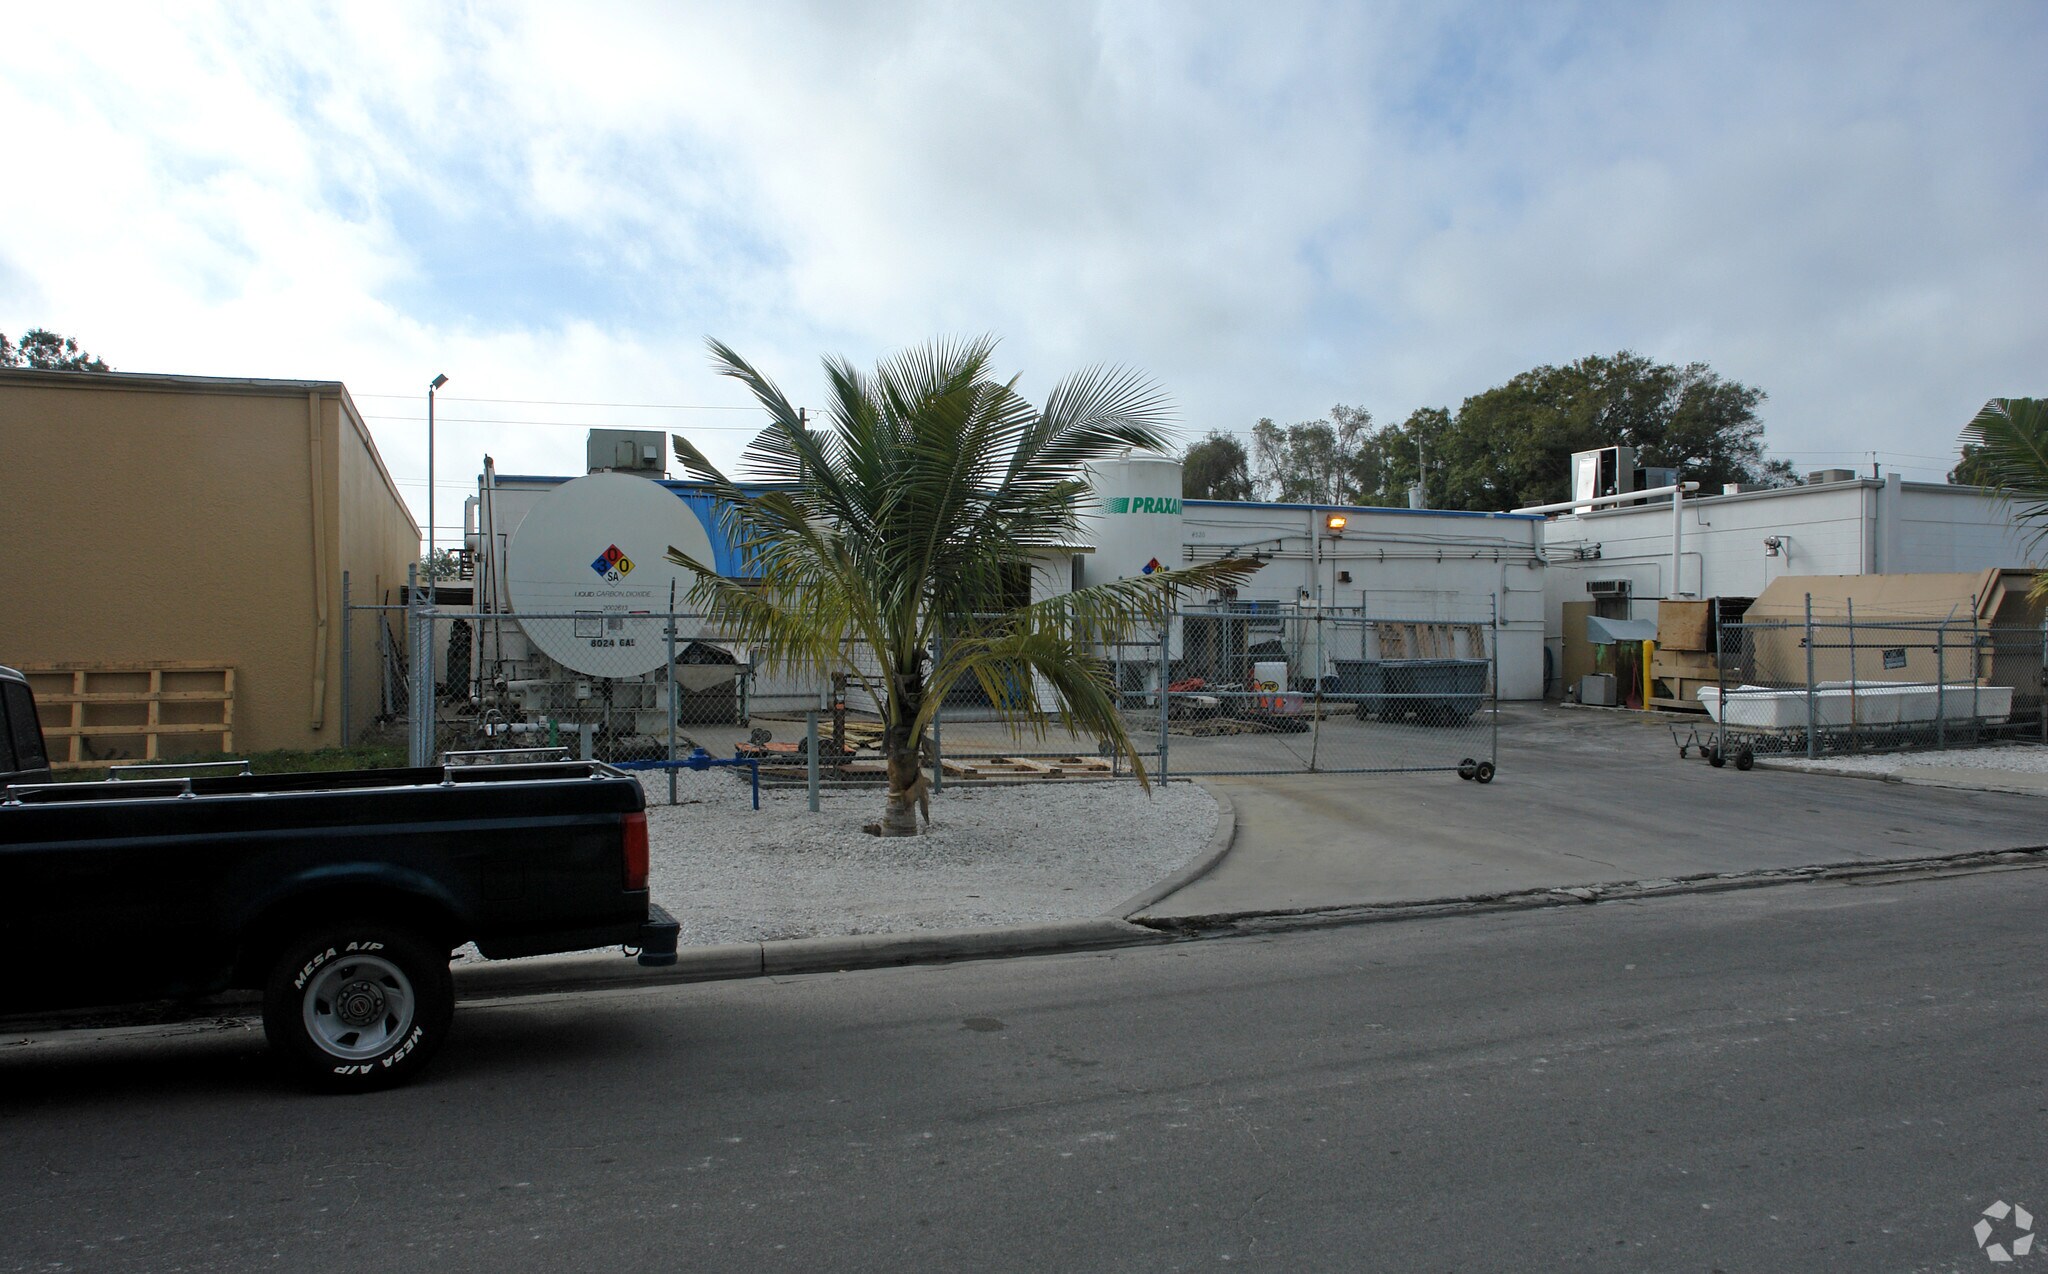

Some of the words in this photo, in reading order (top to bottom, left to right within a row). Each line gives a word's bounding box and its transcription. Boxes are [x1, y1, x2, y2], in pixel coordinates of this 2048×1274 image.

[608, 548, 618, 561] 0
[597, 558, 607, 572] 3
[619, 558, 629, 572] 0
[608, 572, 618, 582] SA
[596, 590, 624, 598] CARBON
[590, 640, 615, 648] 8024
[619, 638, 636, 646] GAL
[294, 947, 337, 990] MESA
[345, 941, 384, 952] A/P
[382, 1025, 424, 1068] MESA
[333, 1063, 374, 1075] A/P
